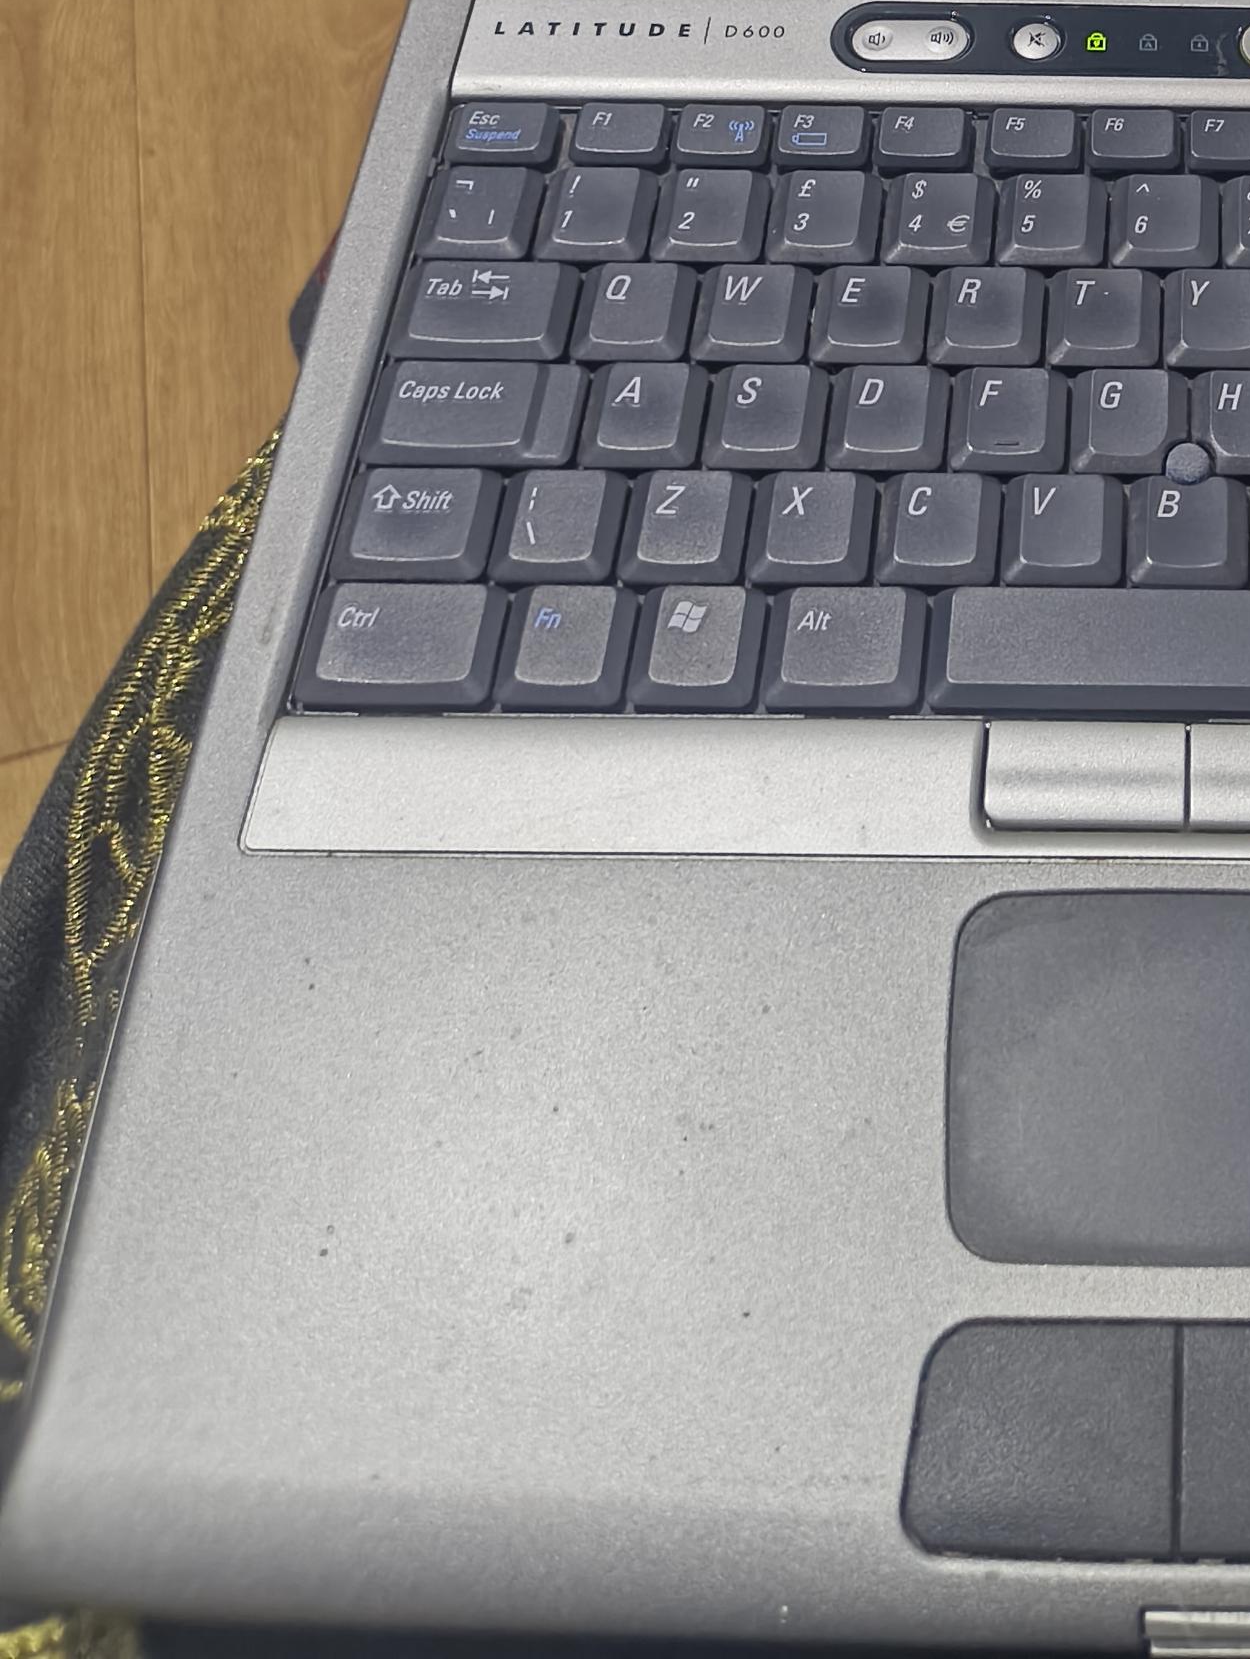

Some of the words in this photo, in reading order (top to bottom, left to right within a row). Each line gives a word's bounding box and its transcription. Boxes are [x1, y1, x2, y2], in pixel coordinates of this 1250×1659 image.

[495, 22, 690, 37] LATITUDE
[725, 25, 784, 38] D600
[469, 111, 500, 125] Esc
[593, 112, 612, 125] F1
[694, 114, 714, 127] F2
[794, 114, 814, 128] F3
[895, 116, 914, 129] F4
[1006, 117, 1025, 130] F5
[1105, 118, 1124, 131] F6
[1205, 119, 1224, 131] F7
[466, 128, 521, 141] Suspend
[427, 279, 462, 295] Tab
[606, 275, 631, 299] Q
[725, 276, 762, 301] W
[842, 278, 865, 302] E
[958, 279, 981, 303] R
[1076, 281, 1095, 305] T
[1191, 281, 1209, 305] Y
[399, 381, 450, 402] Caps
[454, 382, 503, 399] Lock
[402, 491, 452, 512] Shift
[338, 607, 379, 628] Ctrl
[535, 608, 561, 628] Fn
[797, 611, 831, 630] Alt
